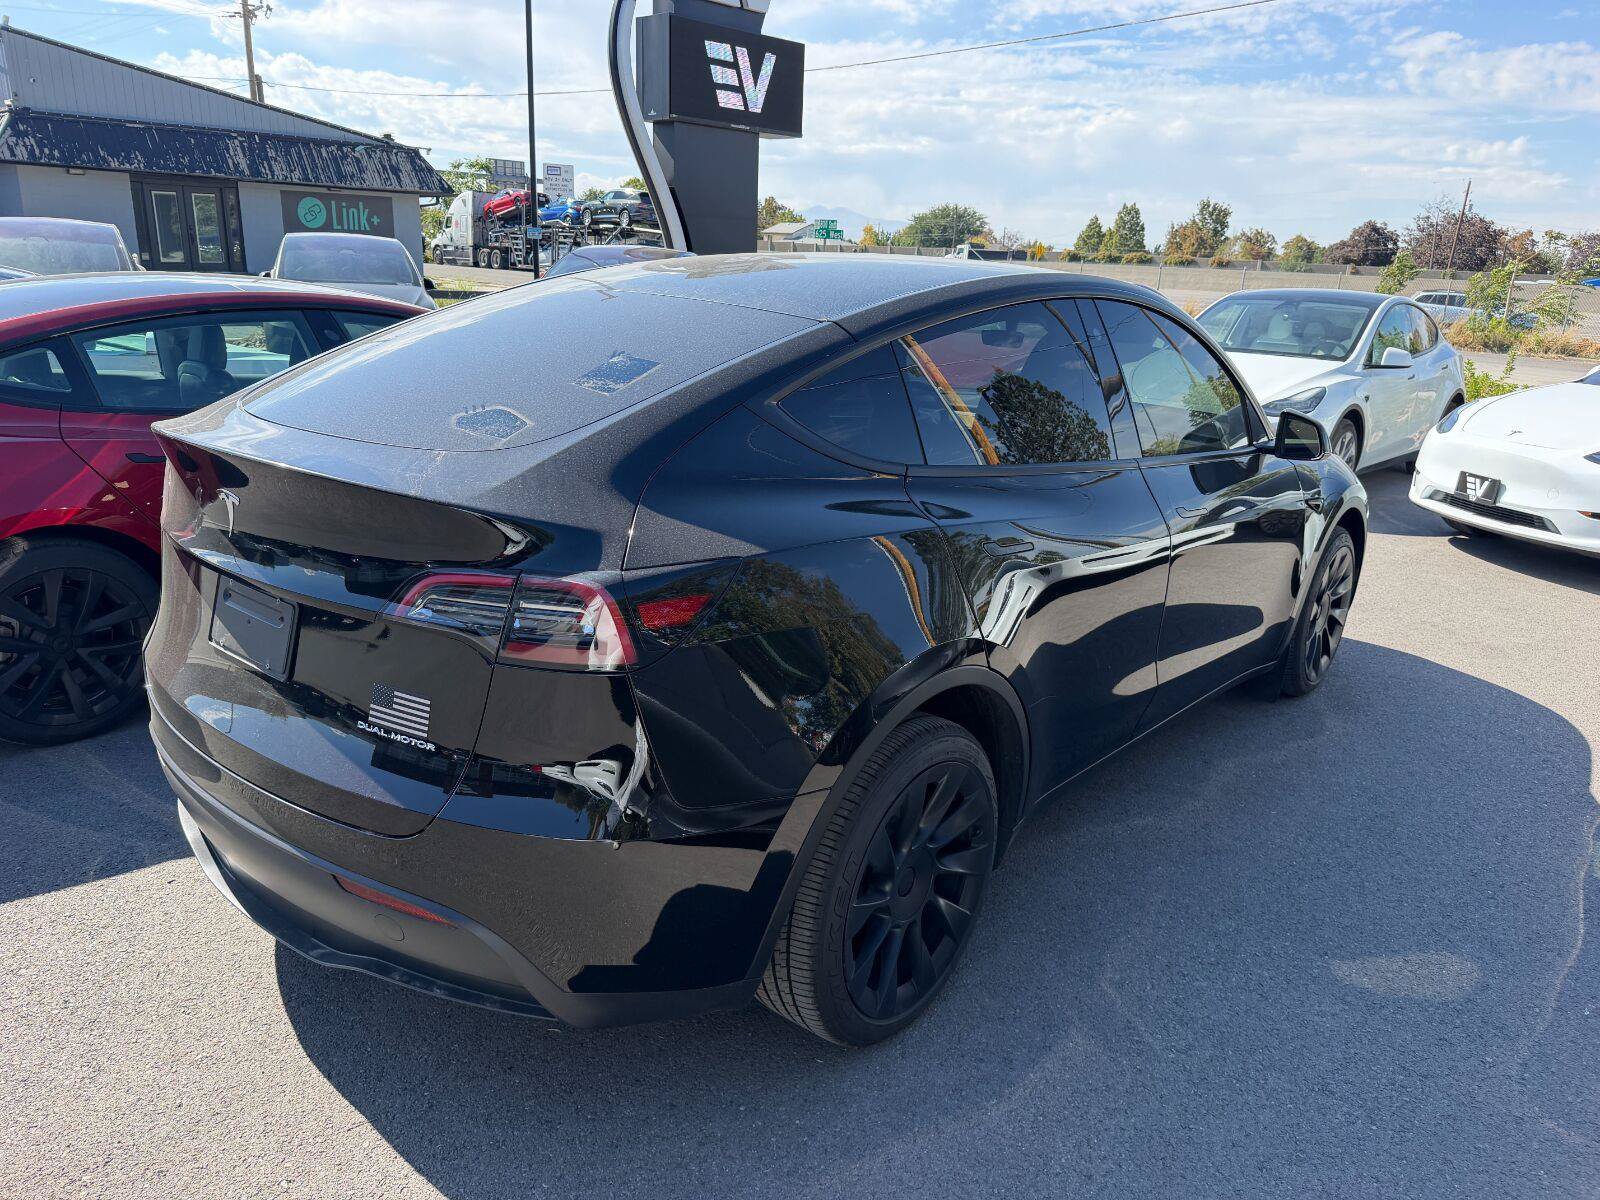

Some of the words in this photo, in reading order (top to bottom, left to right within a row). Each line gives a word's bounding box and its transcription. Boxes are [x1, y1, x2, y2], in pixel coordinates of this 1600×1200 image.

[704, 40, 777, 113] EV
[357, 720, 388, 738] DUAL
[390, 731, 436, 752] MOTOR
